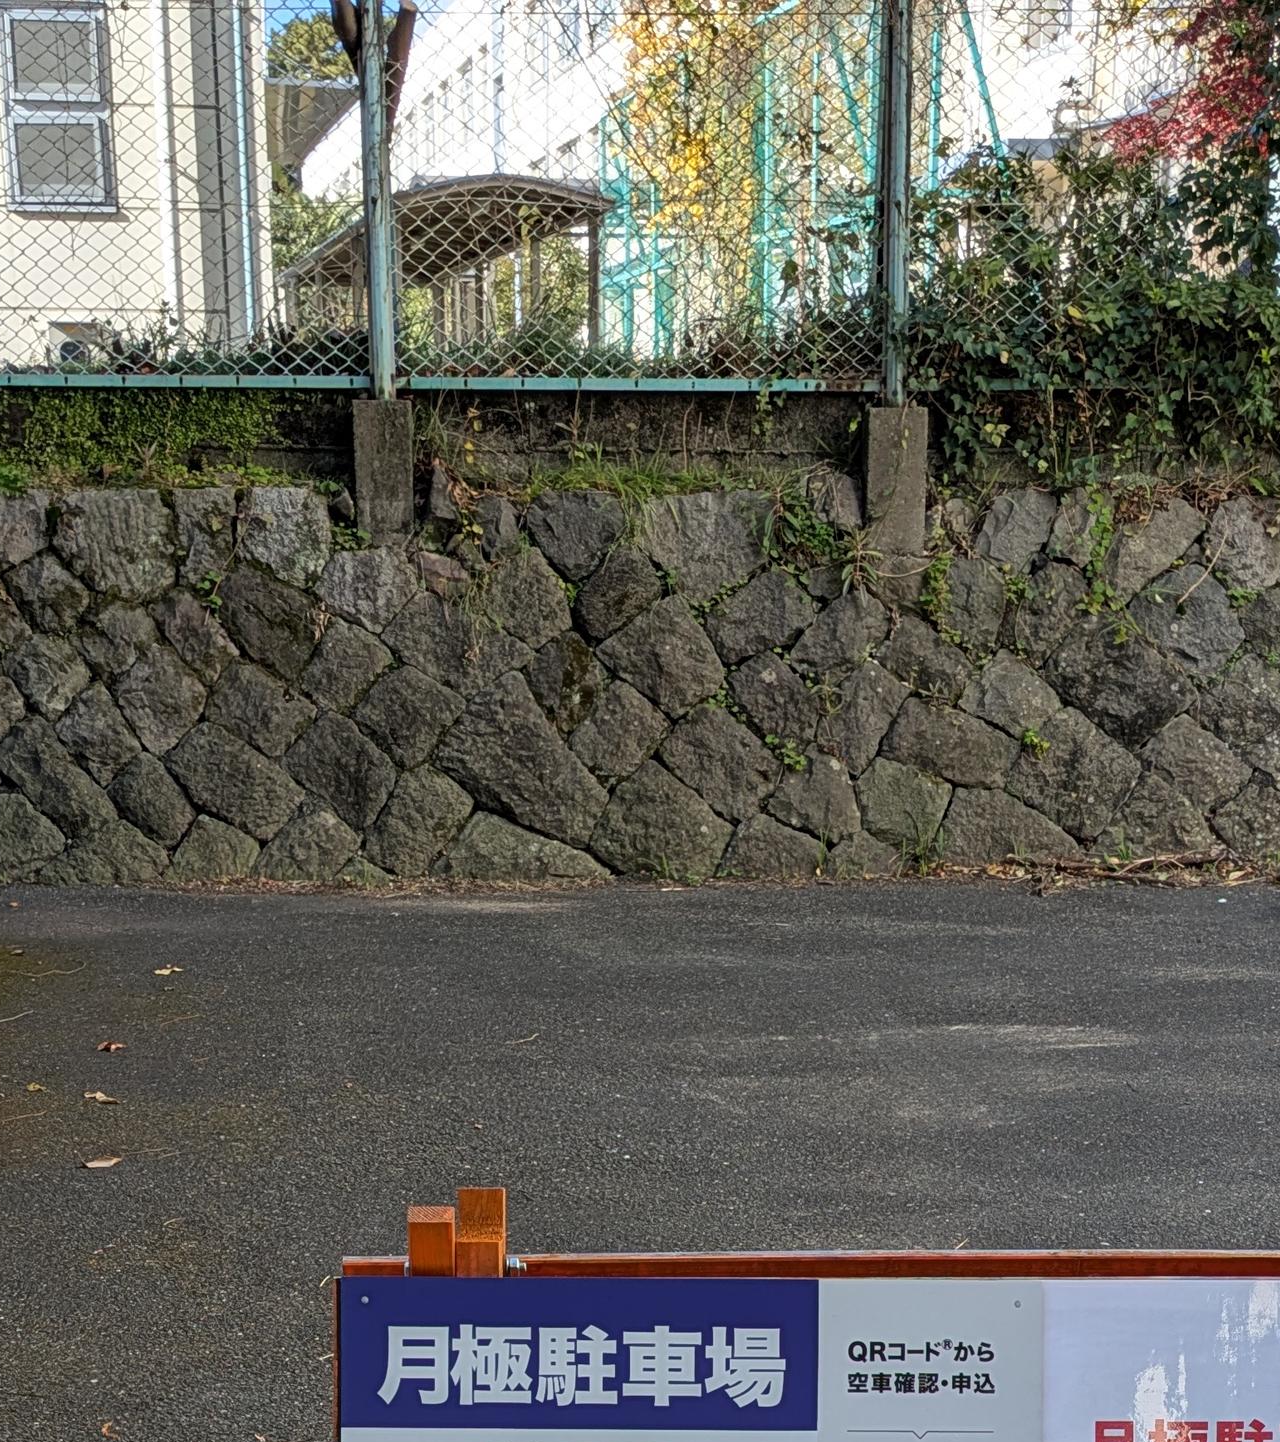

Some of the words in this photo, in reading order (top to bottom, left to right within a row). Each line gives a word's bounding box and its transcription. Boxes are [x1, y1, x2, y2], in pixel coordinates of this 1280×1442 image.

[377, 1324, 786, 1407] 月極駐車場
[848, 1372, 995, 1393] 空車確認・申込
